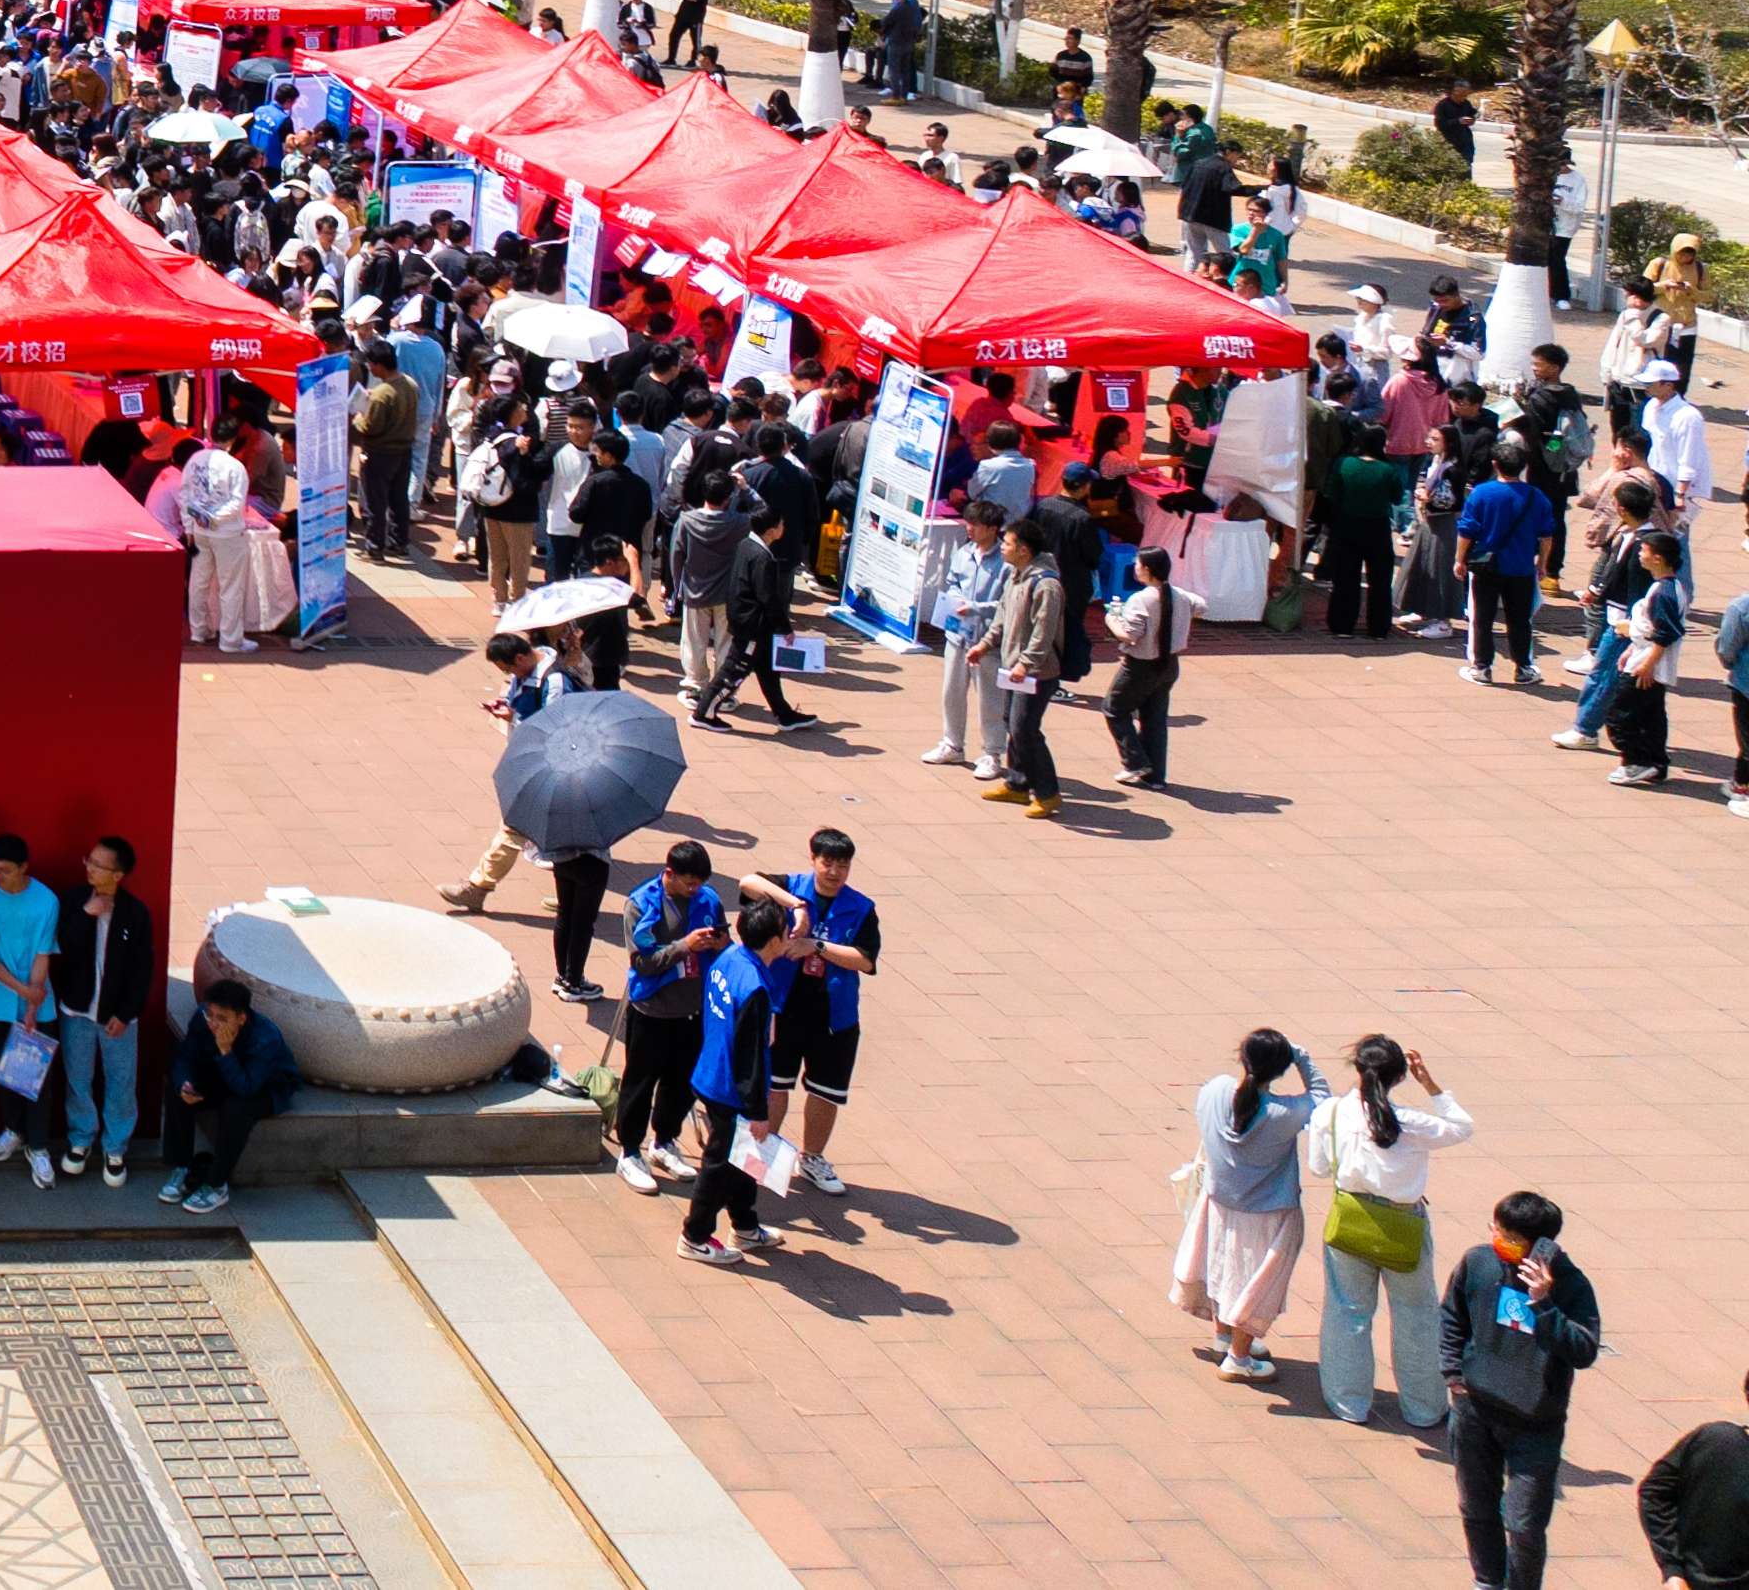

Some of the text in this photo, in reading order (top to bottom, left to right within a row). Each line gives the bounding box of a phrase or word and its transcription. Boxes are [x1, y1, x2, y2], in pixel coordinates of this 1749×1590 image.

[224, 7, 281, 22] 众才校招
[210, 338, 263, 361] 纳职
[975, 338, 1068, 360] 众才校招
[1203, 335, 1255, 359] 纳职
